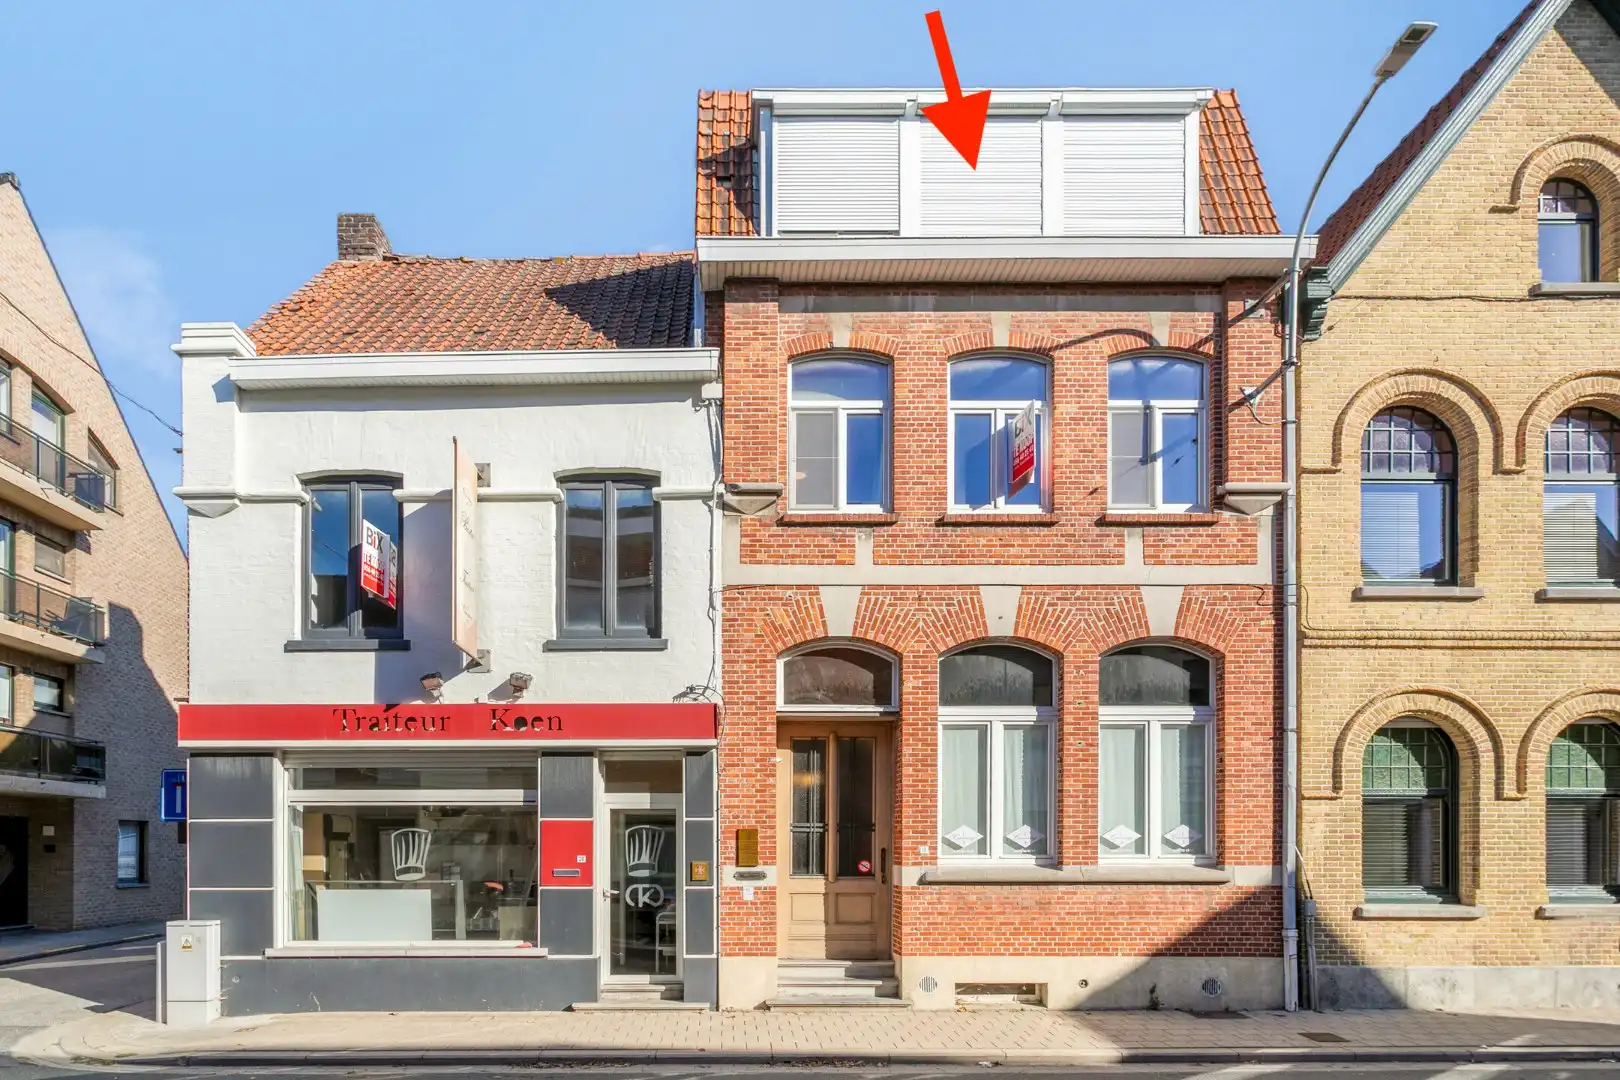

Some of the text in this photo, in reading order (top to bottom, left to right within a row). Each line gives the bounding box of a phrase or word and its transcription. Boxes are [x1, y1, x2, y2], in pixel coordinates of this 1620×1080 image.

[367, 527, 384, 553] BiX
[332, 708, 563, 732] Traiteur Koen
